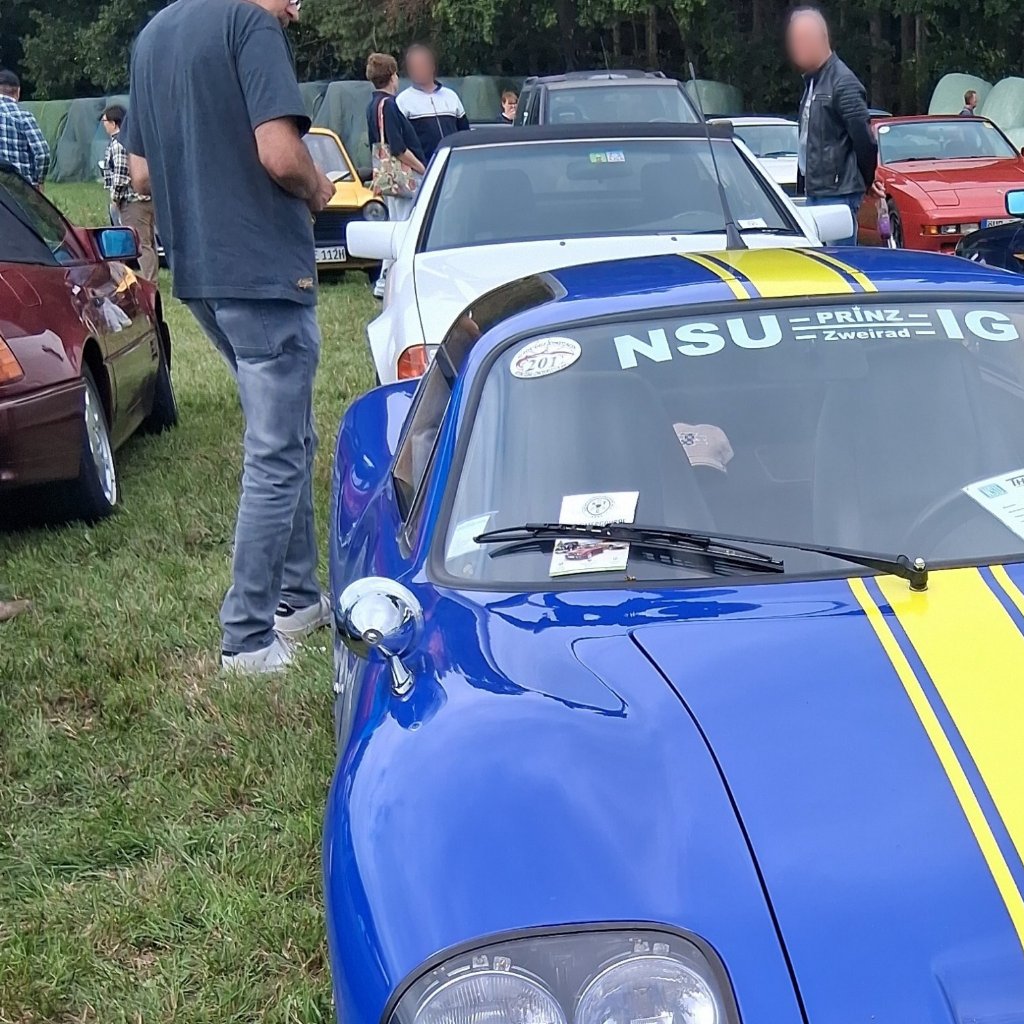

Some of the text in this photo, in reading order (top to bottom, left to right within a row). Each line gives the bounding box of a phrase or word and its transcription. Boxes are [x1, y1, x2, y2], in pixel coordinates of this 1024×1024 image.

[320, 248, 345, 260] 112H
[816, 306, 904, 324] PRINZ
[936, 308, 1020, 342] IG
[613, 314, 784, 370] NSU
[822, 328, 911, 341] Zweirad
